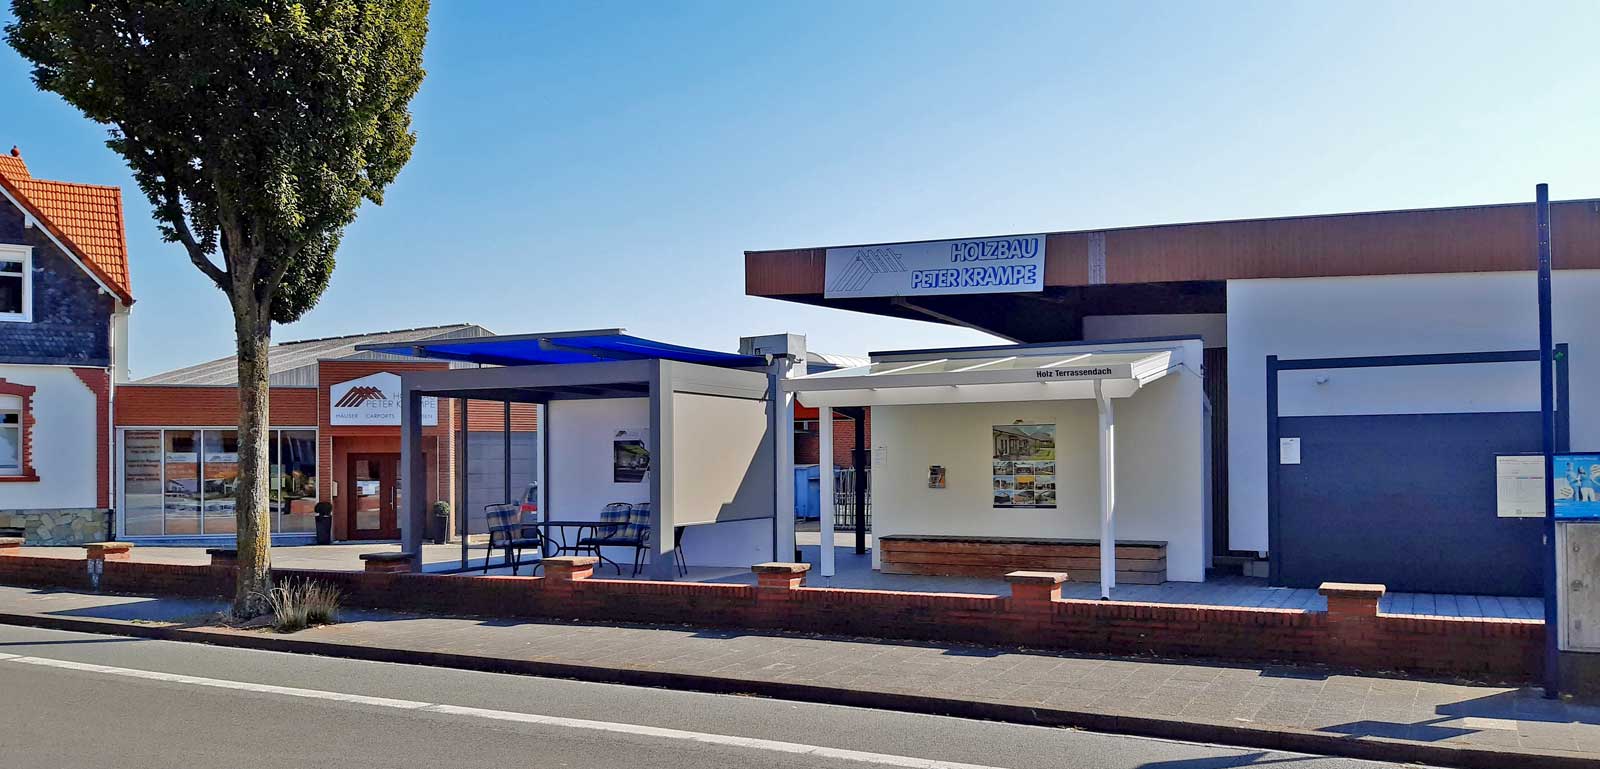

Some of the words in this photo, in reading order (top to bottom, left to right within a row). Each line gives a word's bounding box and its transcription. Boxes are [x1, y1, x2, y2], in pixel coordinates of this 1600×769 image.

[951, 238, 1038, 262] HOLZBAU
[911, 268, 960, 289] PETER
[962, 265, 1037, 288] KRAMPE
[1036, 370, 1053, 378] Holz
[1055, 367, 1112, 377] Terrassendach
[366, 400, 393, 408] PETER
